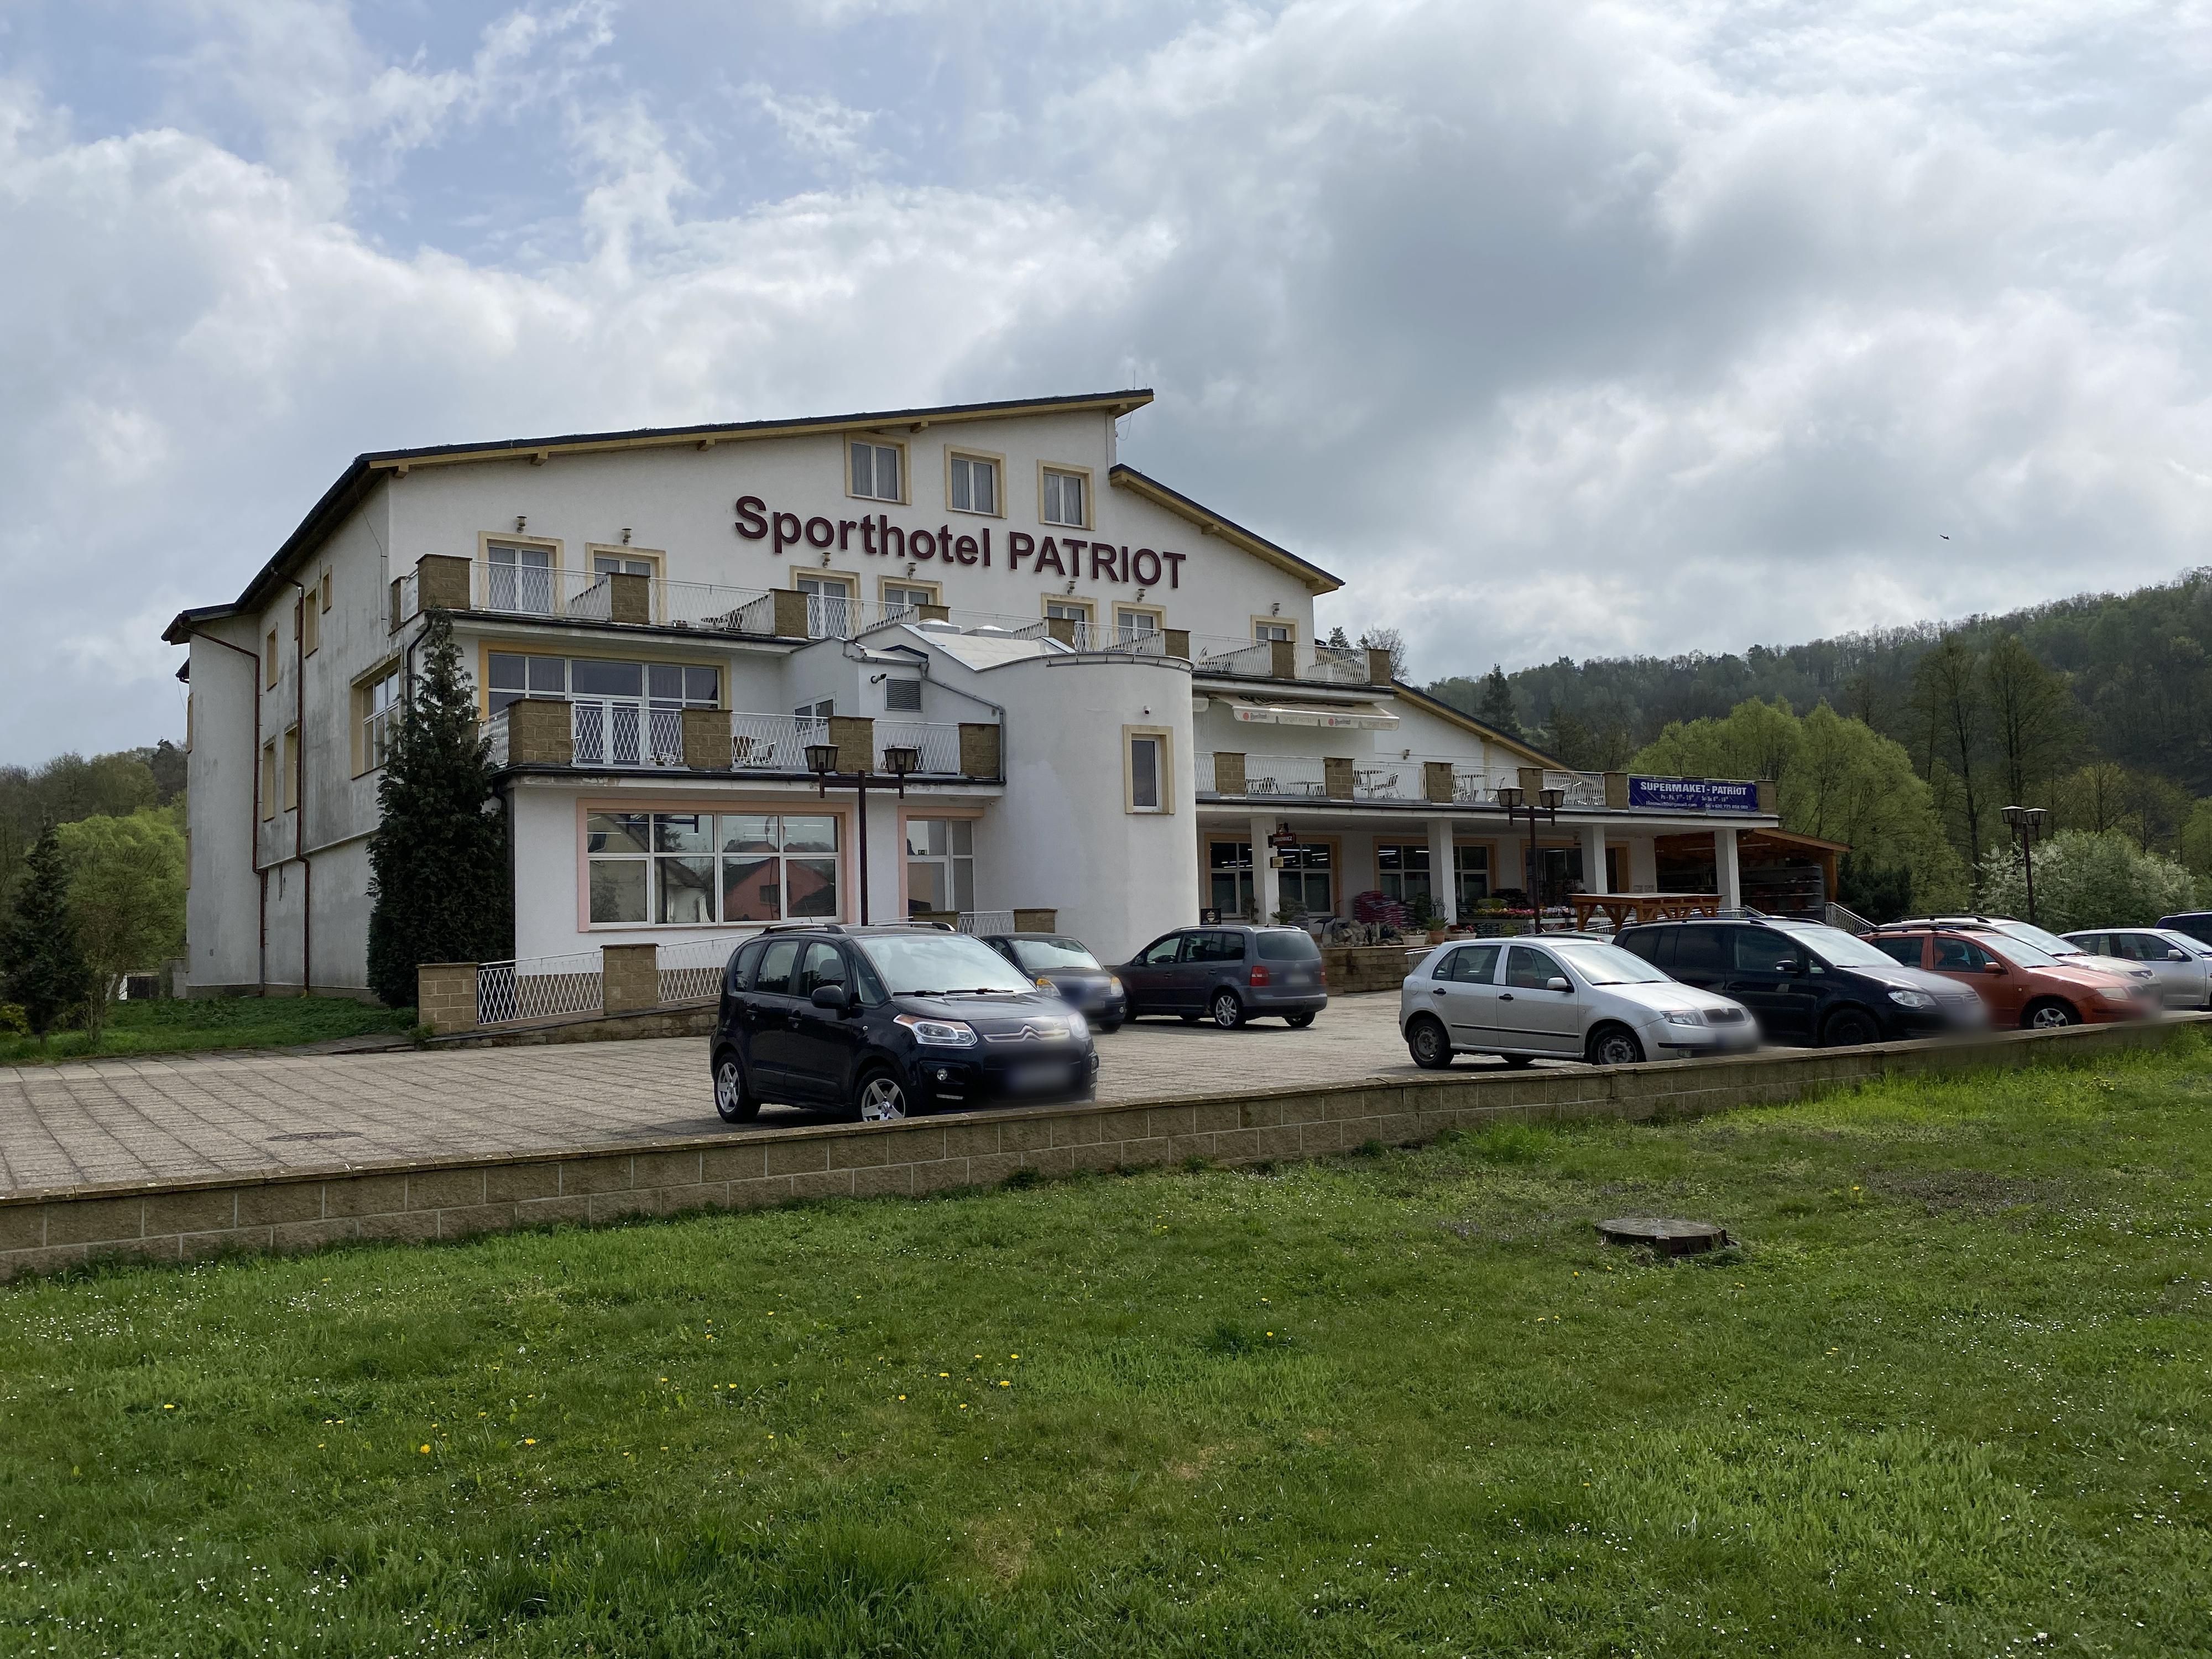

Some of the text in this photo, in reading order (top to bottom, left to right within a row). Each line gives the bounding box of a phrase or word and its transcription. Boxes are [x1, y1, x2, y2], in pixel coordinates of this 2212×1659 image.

[735, 495, 1186, 588] Sporthotel PATRIOT
[1640, 781, 1705, 793] SUPERMAKET
[1712, 786, 1747, 795] PATRIOT
